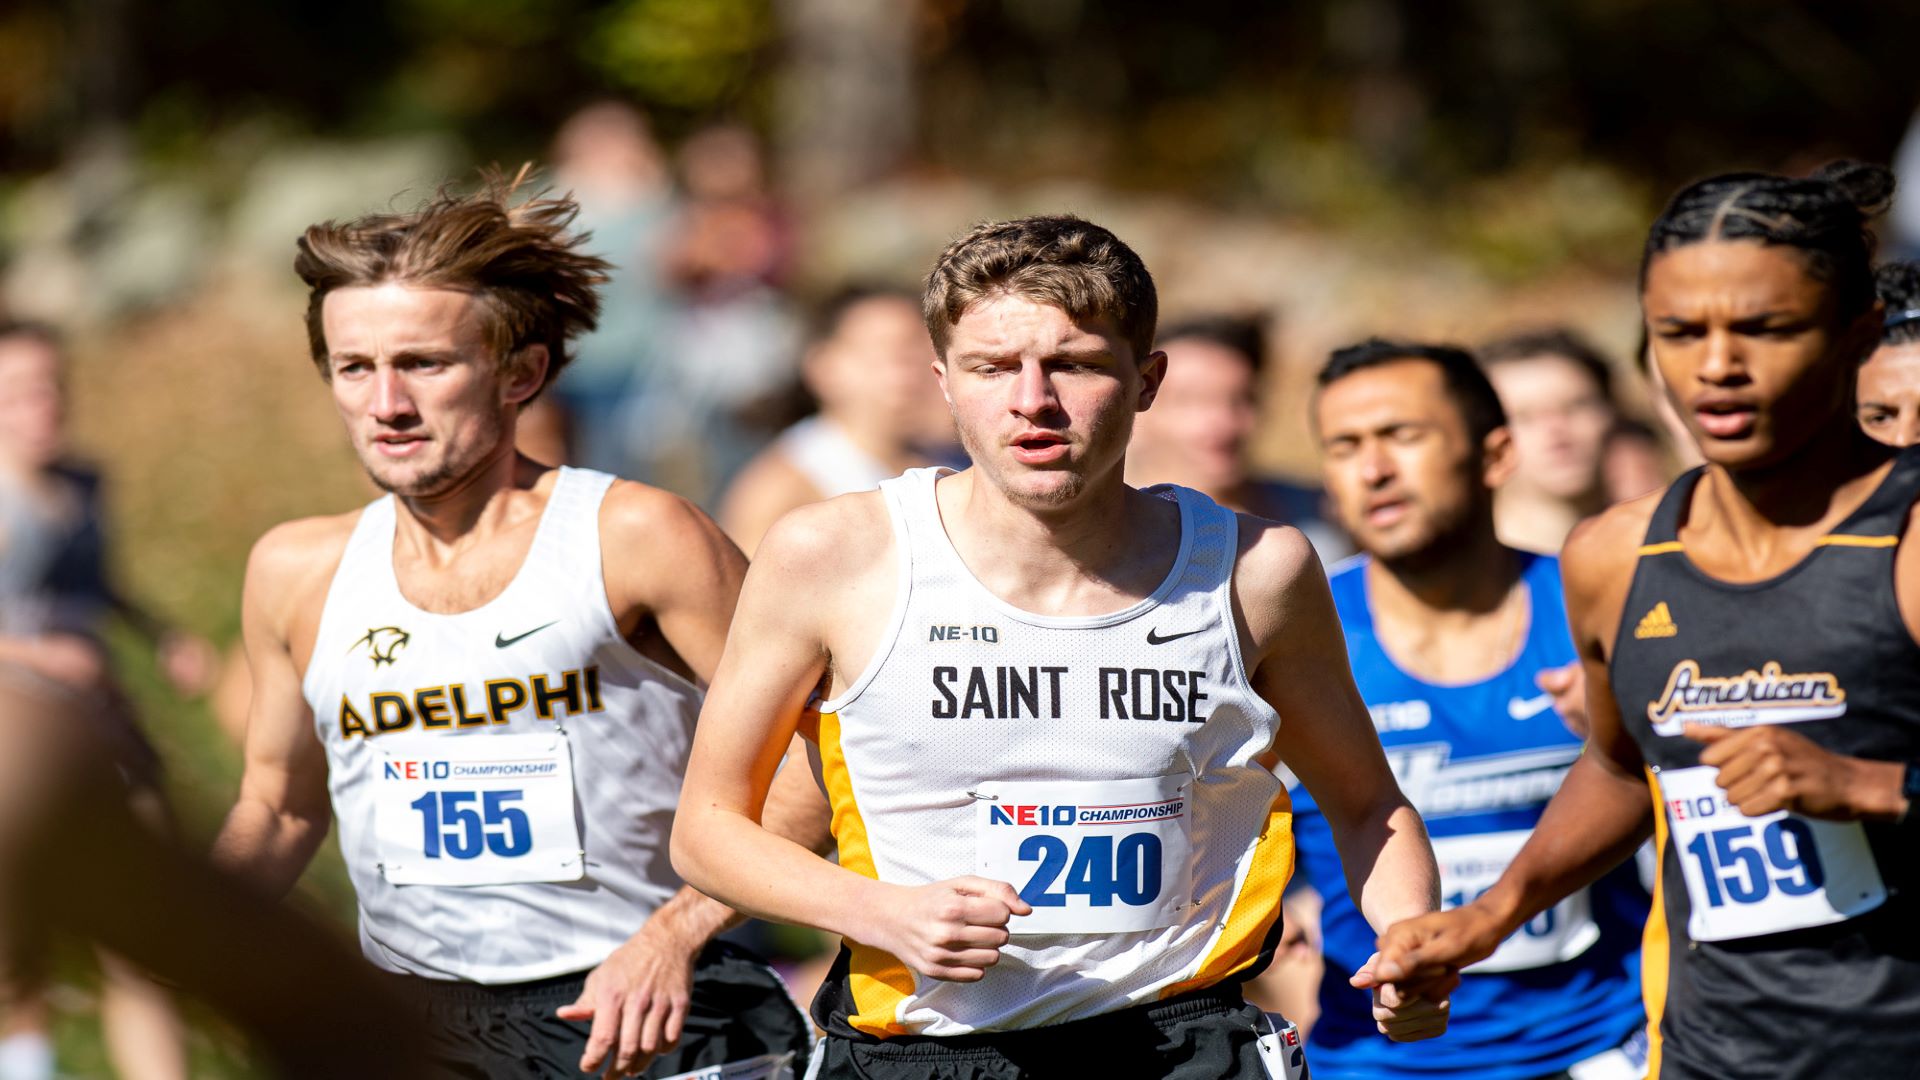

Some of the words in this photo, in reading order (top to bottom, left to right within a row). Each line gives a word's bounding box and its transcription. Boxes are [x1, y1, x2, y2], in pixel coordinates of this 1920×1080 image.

[929, 625, 999, 643] NE-10
[339, 665, 606, 740] ADELPHI
[931, 666, 1069, 719] SAINT
[1099, 667, 1209, 723] ROSE
[1648, 659, 1847, 724] American
[384, 761, 449, 780] NE10
[453, 762, 558, 777] CHAMPIONSHIP
[410, 789, 534, 860] 155
[990, 804, 1077, 826] NE10
[1079, 801, 1184, 822] CHAMPIONSHIP
[1667, 796, 1716, 821] E10
[1017, 832, 1163, 908] 240
[1687, 818, 1825, 909] 159
